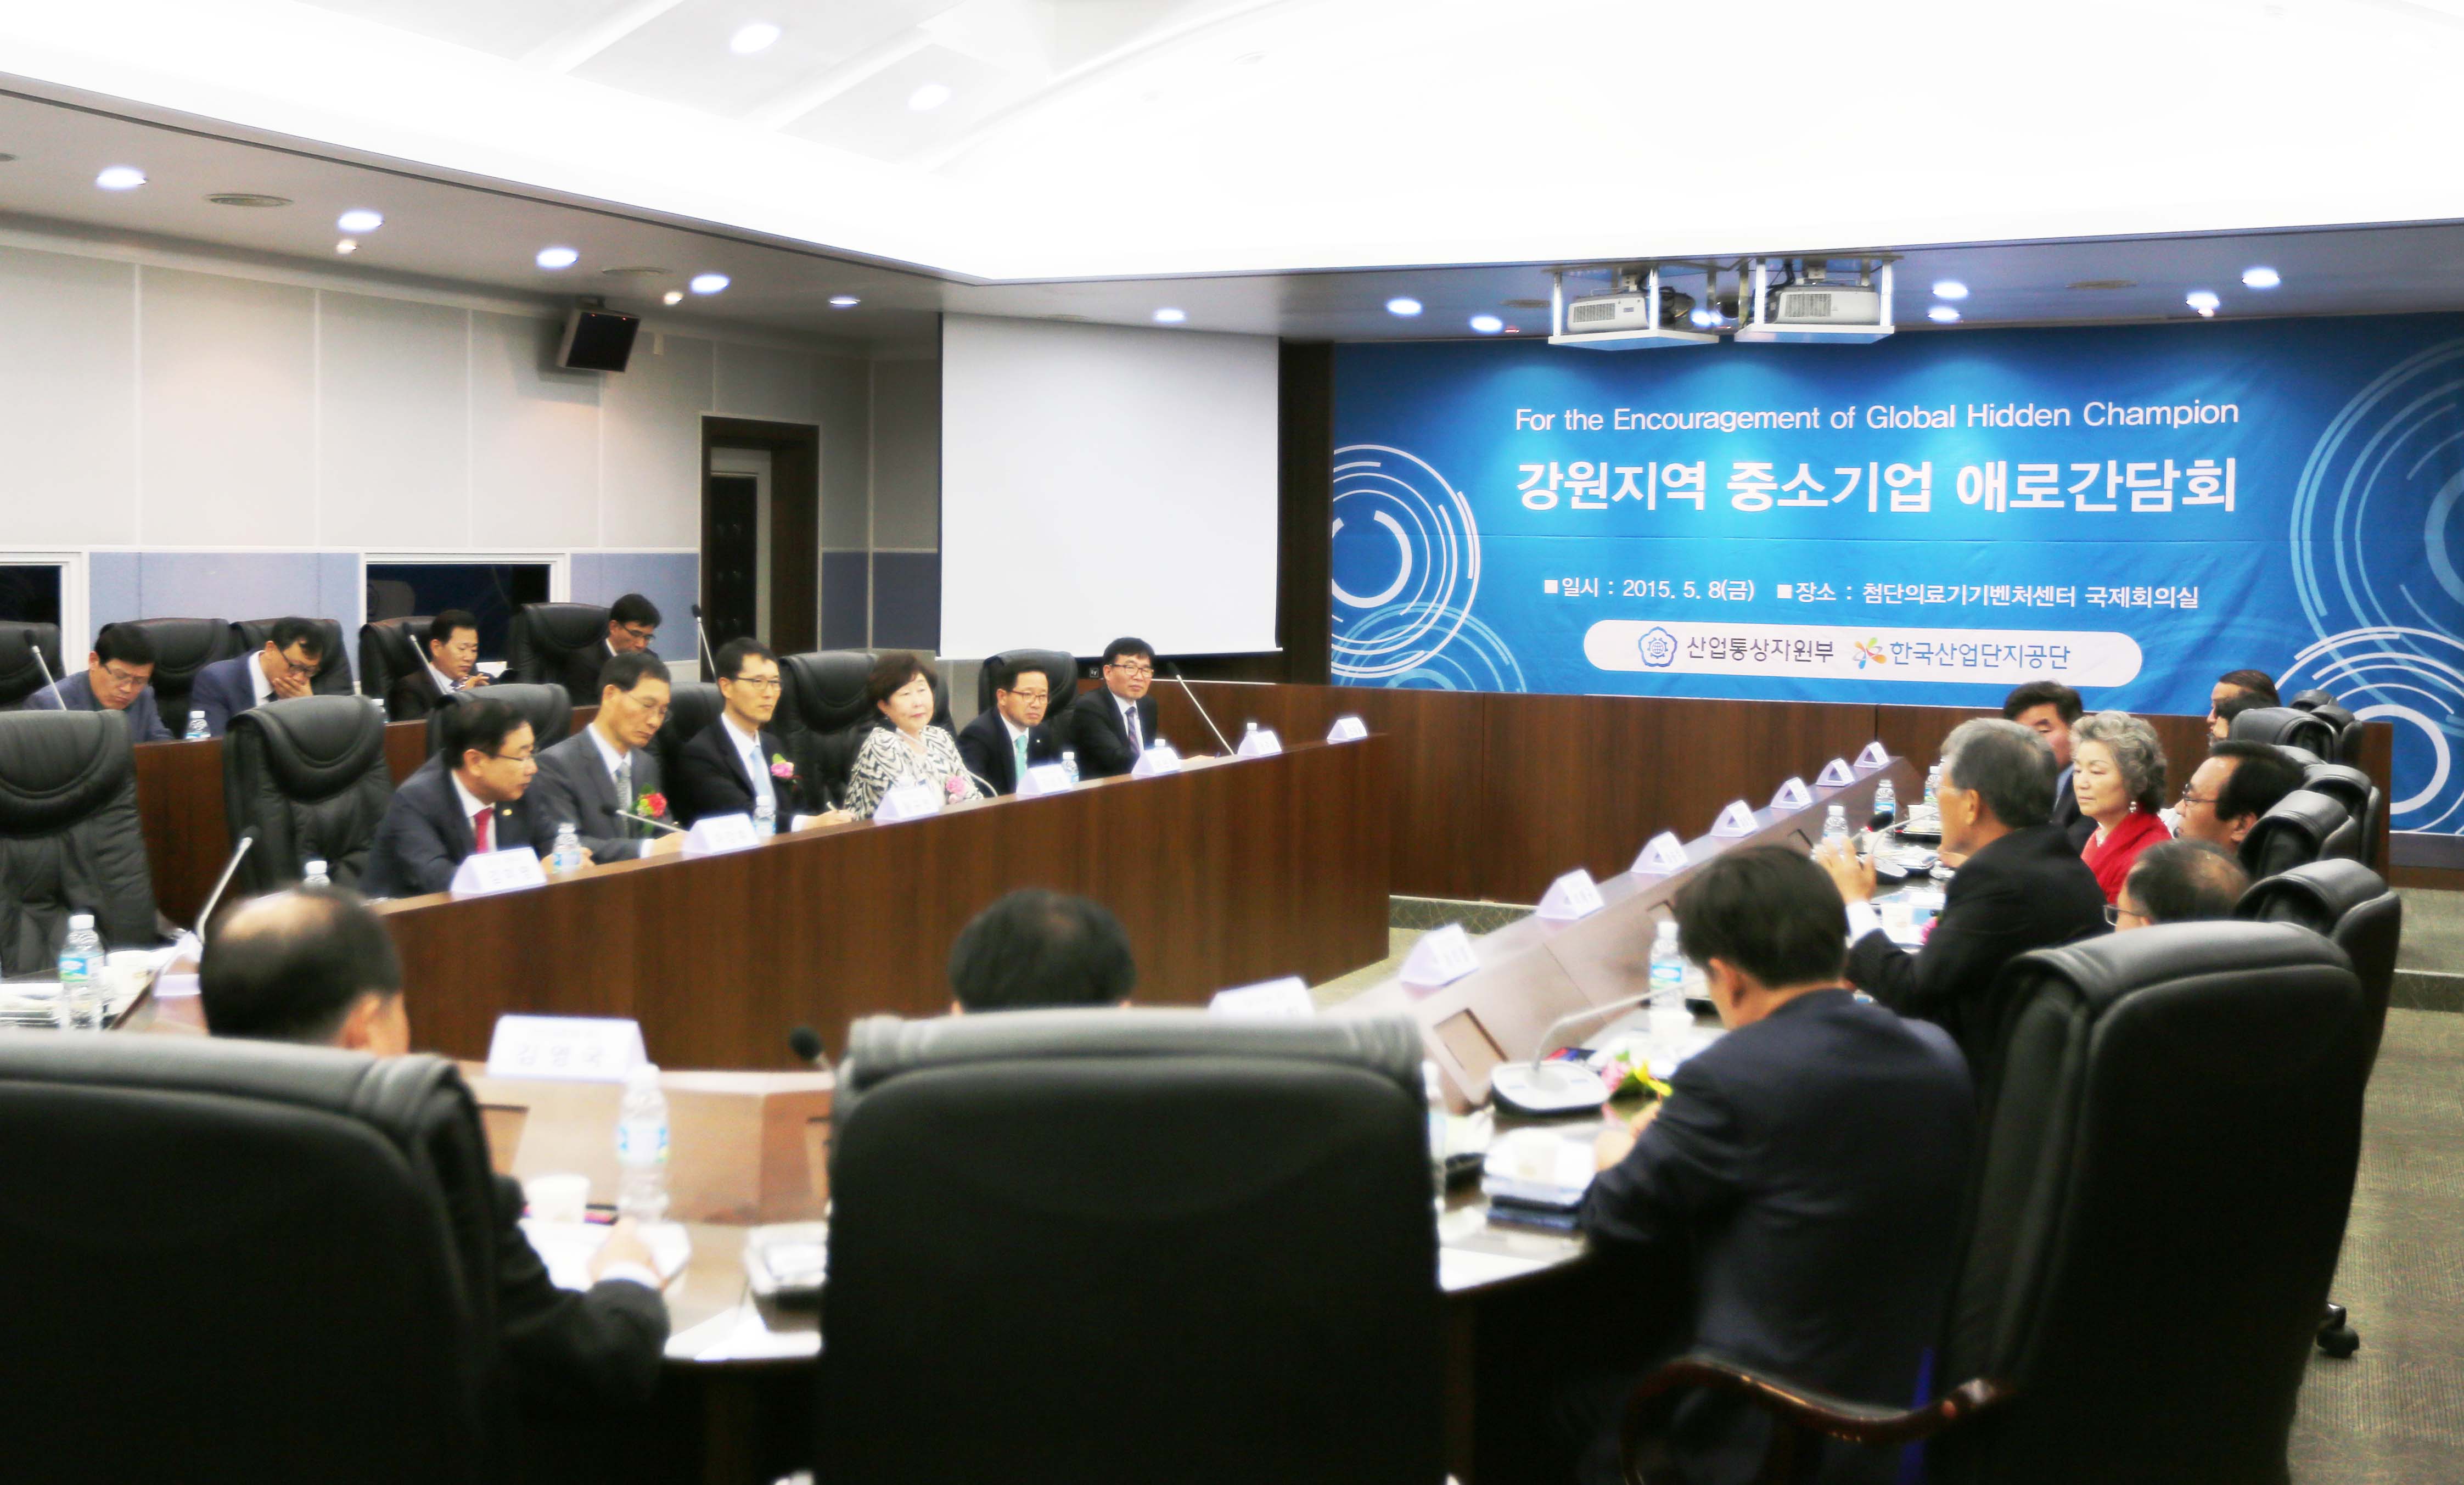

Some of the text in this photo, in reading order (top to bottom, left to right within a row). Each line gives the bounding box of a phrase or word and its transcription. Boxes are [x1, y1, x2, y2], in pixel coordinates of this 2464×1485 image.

[1517, 400, 2238, 432] For the Encouragement of Global Hidden Champion
[1517, 458, 2235, 512] 강원지역 중소기업 애로간담회
[1562, 578, 1598, 597] 일시
[1623, 580, 1675, 598] 2015.
[1684, 581, 1700, 599] 5.
[1709, 580, 1754, 601] 8(금)
[1796, 582, 1836, 602] 장소
[1863, 583, 2075, 607] 첨단의료기기벤처센터
[2085, 587, 2197, 608] 국제회의실
[1687, 637, 1833, 663] 산업통상자원부
[1890, 642, 2070, 669] 한국산업단지공단
